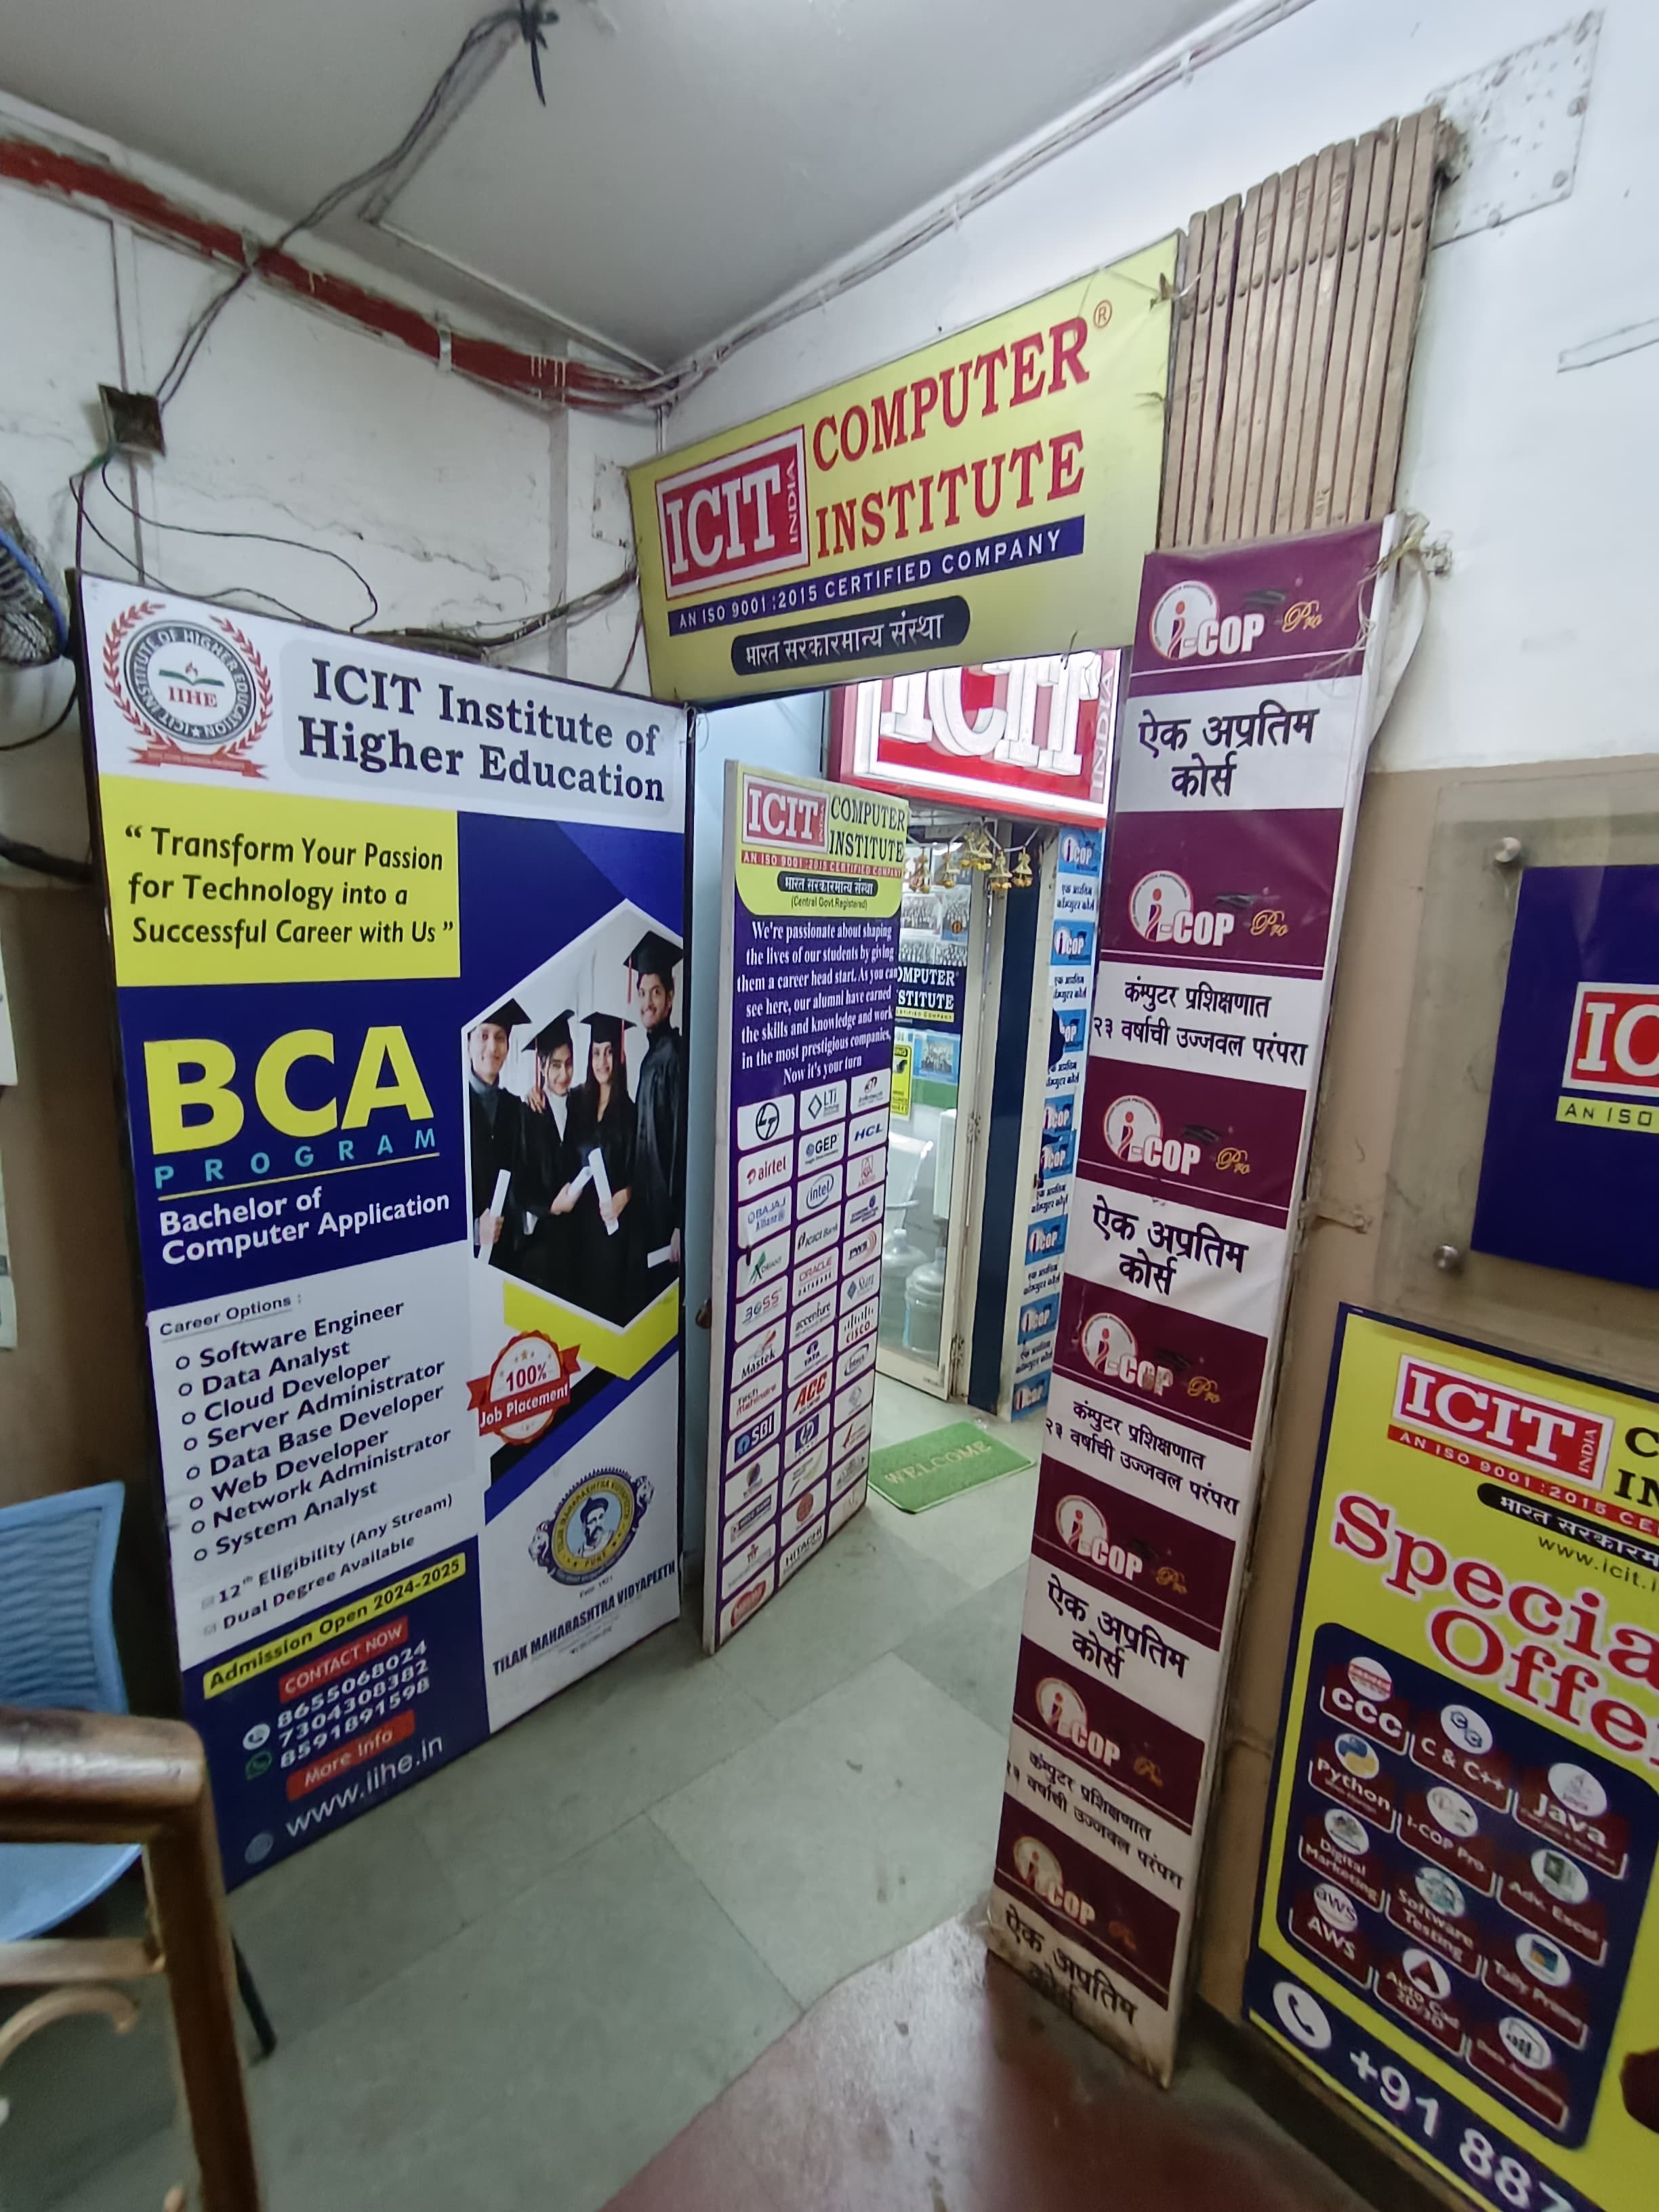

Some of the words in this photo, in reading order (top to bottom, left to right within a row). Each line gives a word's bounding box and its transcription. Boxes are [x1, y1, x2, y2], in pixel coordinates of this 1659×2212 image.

[813, 314, 1091, 472] COMPUTER
[665, 462, 781, 577] ICIT
[785, 459, 799, 543] INDIA
[816, 430, 1085, 558] INSTITUTE
[680, 613, 697, 628] AN
[703, 607, 725, 624] ISO
[731, 596, 766, 617] 9001
[825, 558, 930, 599] CERTIFIED
[941, 529, 1061, 574] COMPANY
[745, 640, 779, 666] भारत
[785, 623, 882, 659] सरकारमान्य
[890, 610, 945, 645] संस्था
[169, 686, 217, 708] IIHE
[312, 658, 422, 716] ICIT
[438, 684, 613, 749] Institute
[626, 724, 660, 756] of
[1139, 709, 1191, 758] ऐक
[1202, 699, 1320, 748] अप्रतिम
[298, 716, 460, 775] Higher
[480, 745, 664, 802] Education
[1172, 751, 1237, 797] कोर्स
[748, 787, 819, 840] ICIT
[831, 795, 905, 832] COMPUTER
[302, 838, 356, 868] Your
[365, 842, 443, 871] Passion
[743, 853, 757, 863] AN
[761, 855, 777, 865] ISO
[781, 857, 802, 867] 9001
[830, 830, 904, 862] INSTITUTE
[129, 872, 173, 904] for
[183, 874, 333, 910] Technology
[342, 879, 386, 905] into
[785, 876, 804, 890] भारत
[132, 918, 267, 949] Successful
[276, 920, 352, 944] Career
[360, 920, 404, 944] with
[746, 948, 763, 966] the
[766, 947, 790, 964] lives
[823, 947, 857, 961] students
[786, 922, 835, 943] passionate
[837, 922, 861, 939] about
[863, 922, 892, 941] shaping
[737, 975, 765, 993] them
[1185, 981, 1271, 1018] प्रशिक्षणात
[811, 1013, 855, 1033] knowledge
[1094, 1017, 1113, 1038] २३
[1122, 1017, 1170, 1046] वर्षाची
[1176, 1027, 1245, 1057] उज्जवल
[1253, 1032, 1308, 1066] परंपरा
[776, 1046, 799, 1062] most
[802, 1037, 848, 1062] prestigious
[783, 1069, 805, 1085] Now
[823, 1060, 843, 1080] your
[144, 1025, 434, 1155] BCA
[1565, 1103, 1594, 1119] AN
[1607, 1107, 1652, 1126] ISO
[815, 1134, 838, 1154] GEP
[855, 1123, 883, 1141] HCL
[155, 1128, 435, 1189] PROGRAM
[758, 1155, 786, 1181] airtel
[160, 1195, 287, 1236] Bachelor
[296, 1187, 322, 1211] of
[809, 1181, 830, 1201] intel
[162, 1221, 309, 1265] Computer
[318, 1194, 449, 1237] Application
[1092, 1195, 1139, 1241] ऐक
[1148, 1222, 1248, 1273] अप्रतिम
[1119, 1248, 1177, 1295] कोर्स
[159, 1313, 220, 1336] Career
[226, 1296, 291, 1321] Options
[200, 1326, 306, 1368] Software
[314, 1301, 404, 1338] Engineer
[795, 1302, 830, 1331] accenture
[846, 1322, 873, 1343] CISCO
[203, 1370, 260, 1396] Data
[269, 1342, 350, 1378] Analyst
[205, 1388, 274, 1422] Cloud
[283, 1355, 390, 1399] Developer
[506, 1362, 546, 1391] 100%
[794, 1371, 827, 1413] ACC
[207, 1410, 289, 1448] Server
[298, 1361, 445, 1420] Administrator
[210, 1444, 270, 1476] Data
[279, 1424, 332, 1453] Base
[340, 1385, 444, 1431] Developer
[480, 1408, 502, 1428] Job
[507, 1384, 569, 1417] Placement
[1405, 1370, 1576, 1462] ICIT
[1578, 1429, 1597, 1473] INDIA
[752, 1416, 773, 1446] SBI
[211, 1472, 267, 1502] Web
[276, 1429, 389, 1480] Developer
[213, 1478, 312, 1529] Network
[319, 1429, 451, 1488] Administrator
[884, 1441, 991, 1485] WELCOME
[1400, 1432, 1426, 1449] AN
[1436, 1444, 1470, 1465] ISO
[1480, 1461, 1530, 1488] 9001
[216, 1513, 297, 1555] System
[304, 1481, 378, 1521] Analyst
[1500, 1496, 1552, 1526] भारत
[259, 1538, 345, 1586] Eligibility
[350, 1525, 386, 1549] (Any
[392, 1493, 453, 1527] Stream)
[223, 1600, 267, 1629] Dual
[274, 1574, 335, 1607] Degree
[340, 1536, 415, 1577] Available
[209, 1631, 312, 1689] Admission
[319, 1605, 367, 1635] Open
[373, 1559, 459, 1610] 2024-2025
[493, 1644, 528, 1676] TILAK
[531, 1595, 615, 1655] MAHARASHTRA
[617, 1559, 675, 1605] VIDYAPEETH
[278, 1640, 428, 1728] 8655068024
[284, 1647, 361, 1694] CONTACT
[367, 1624, 403, 1654] NOW
[279, 1660, 429, 1748] 7304308382
[280, 1680, 430, 1769] 8591891598
[1332, 1687, 1402, 1738] CCC
[304, 1753, 352, 1788] More
[358, 1729, 393, 1757] Info
[1464, 1761, 1504, 1791] C++
[286, 1734, 443, 1837] www.iihe.in
[1317, 1759, 1389, 1811] Python
[1534, 1794, 1608, 1849] Java
[1306, 1844, 1378, 1903] Marketing
[1320, 1838, 1366, 1877] Digital
[1308, 1916, 1355, 1960] AWS
[1399, 1888, 1473, 1950] Software
[1404, 1909, 1463, 1962] Testing
[1350, 2049, 1439, 2137] +91
